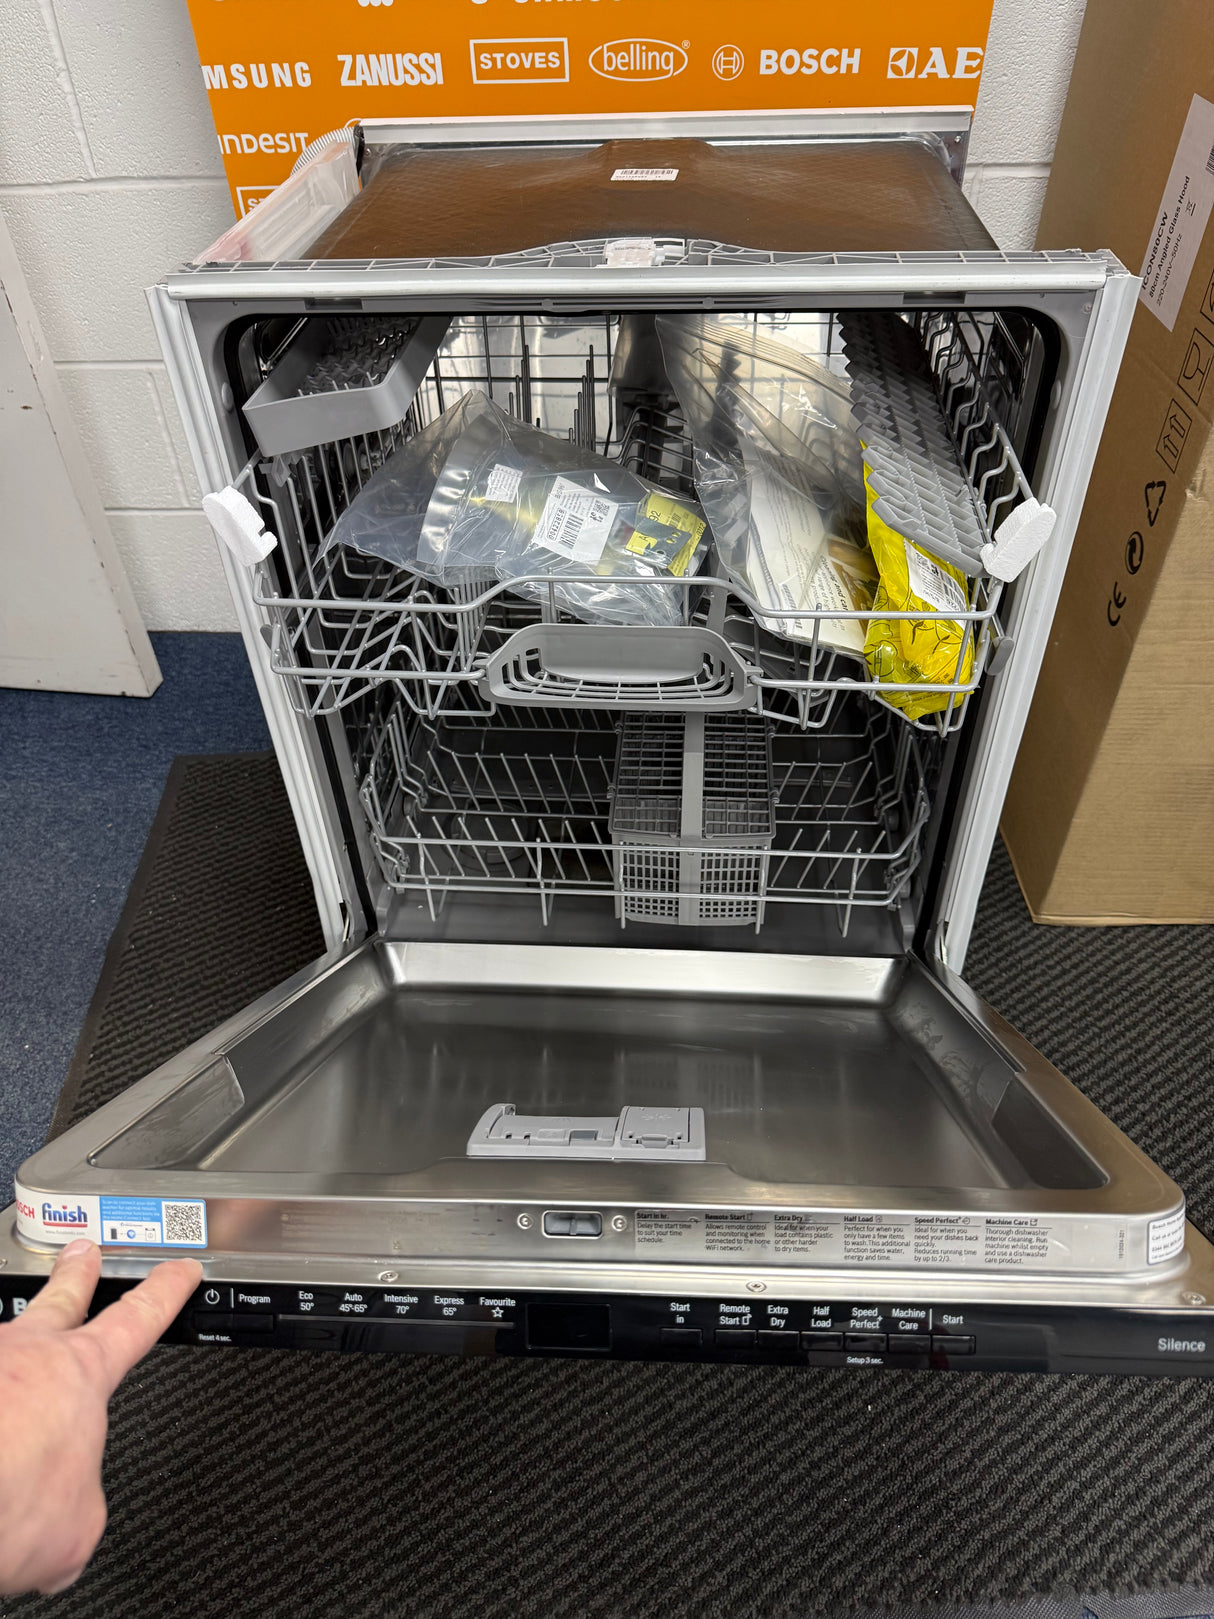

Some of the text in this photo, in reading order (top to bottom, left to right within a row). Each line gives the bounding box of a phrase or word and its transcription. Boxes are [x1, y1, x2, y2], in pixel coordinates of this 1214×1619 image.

[480, 51, 561, 70] STOVES
[603, 43, 674, 77] belling
[759, 47, 861, 75] BOSCH
[337, 52, 444, 87] ZANUSSI
[1157, 236, 1171, 271] Angled
[1168, 206, 1181, 234] Glass
[1177, 175, 1190, 204] Hood
[41, 1202, 88, 1223] finish
[792, 1215, 803, 1223] Dry
[718, 1231, 749, 1239] monitoring
[843, 1232, 856, 1240] only
[985, 1228, 1013, 1236] Thorough
[914, 1247, 939, 1255] Reduces
[985, 1242, 1010, 1250] machine
[843, 1254, 864, 1262] energy
[1013, 1250, 1047, 1258] dishwasher
[238, 1293, 271, 1305] Program
[298, 1291, 314, 1300] Eco
[344, 1292, 363, 1302] Auto
[384, 1294, 419, 1304] Intensive
[434, 1295, 465, 1306] Express
[479, 1297, 516, 1307] Favourite
[670, 1302, 691, 1312] Start
[719, 1303, 751, 1314] Remote
[767, 1305, 789, 1315] Extra
[813, 1306, 830, 1316] Half
[852, 1307, 879, 1318] Speed
[892, 1308, 926, 1319] Machine
[676, 1314, 685, 1324] in
[719, 1315, 740, 1326] Start
[770, 1317, 786, 1328] Dry
[811, 1318, 832, 1328] Load
[942, 1314, 964, 1325] Start
[898, 1320, 919, 1330] Care
[198, 1334, 215, 1342] Reset
[215, 1334, 220, 1342] 4
[1157, 1337, 1206, 1352] Silence
[847, 1356, 865, 1365] Setup
[865, 1356, 871, 1365] 3
